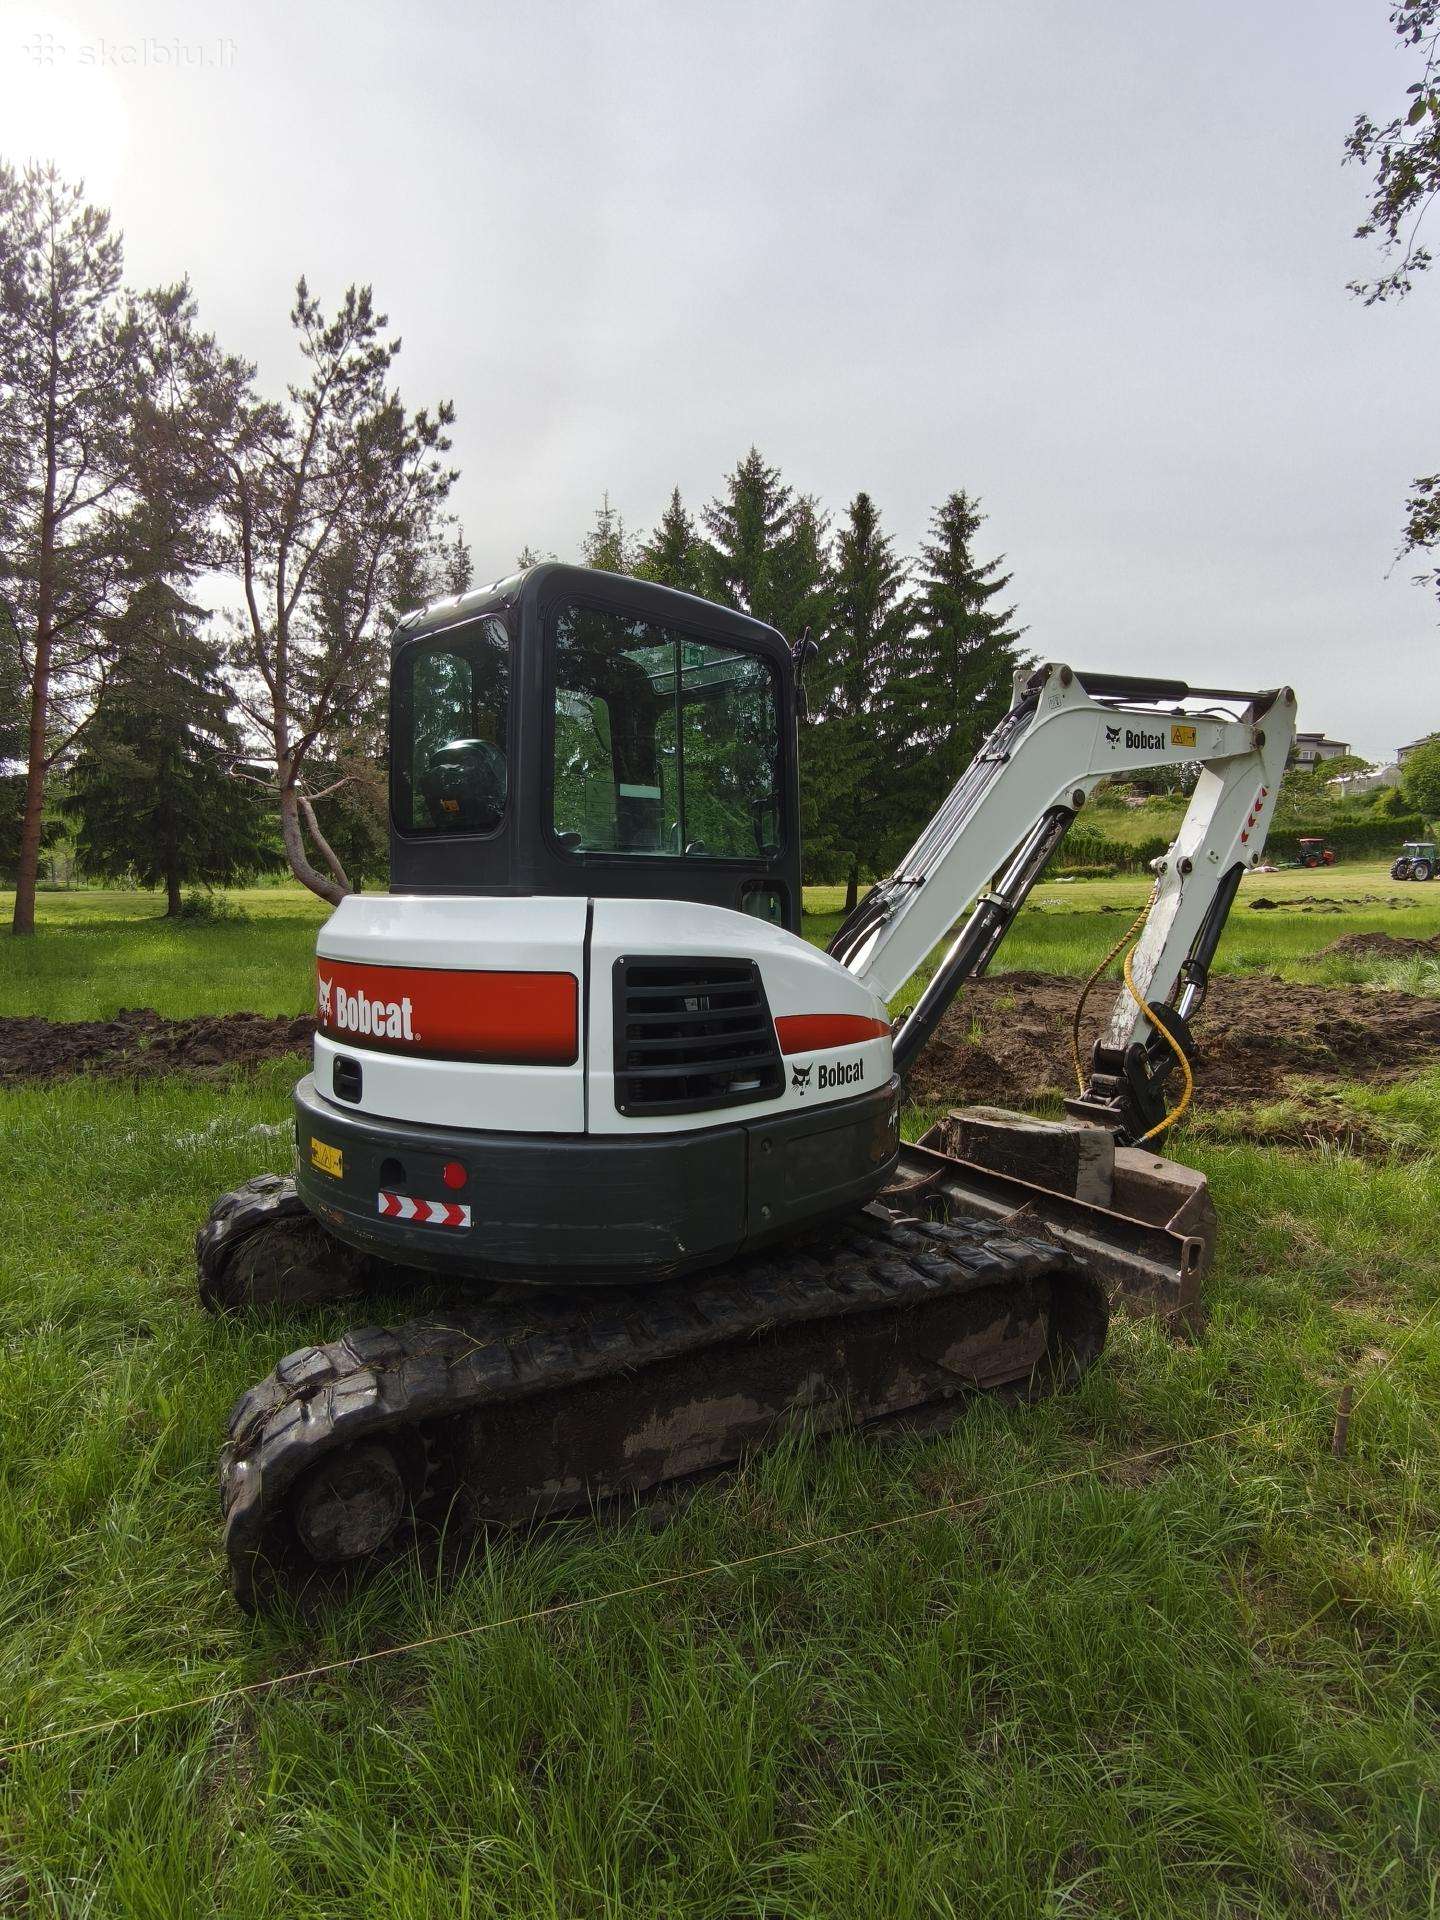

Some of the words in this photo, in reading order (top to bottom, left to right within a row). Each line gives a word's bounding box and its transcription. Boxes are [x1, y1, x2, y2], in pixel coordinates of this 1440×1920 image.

[1125, 730, 1165, 749] Bobcat
[336, 986, 414, 1041] Bobcat
[818, 1058, 864, 1089] Bobcat
